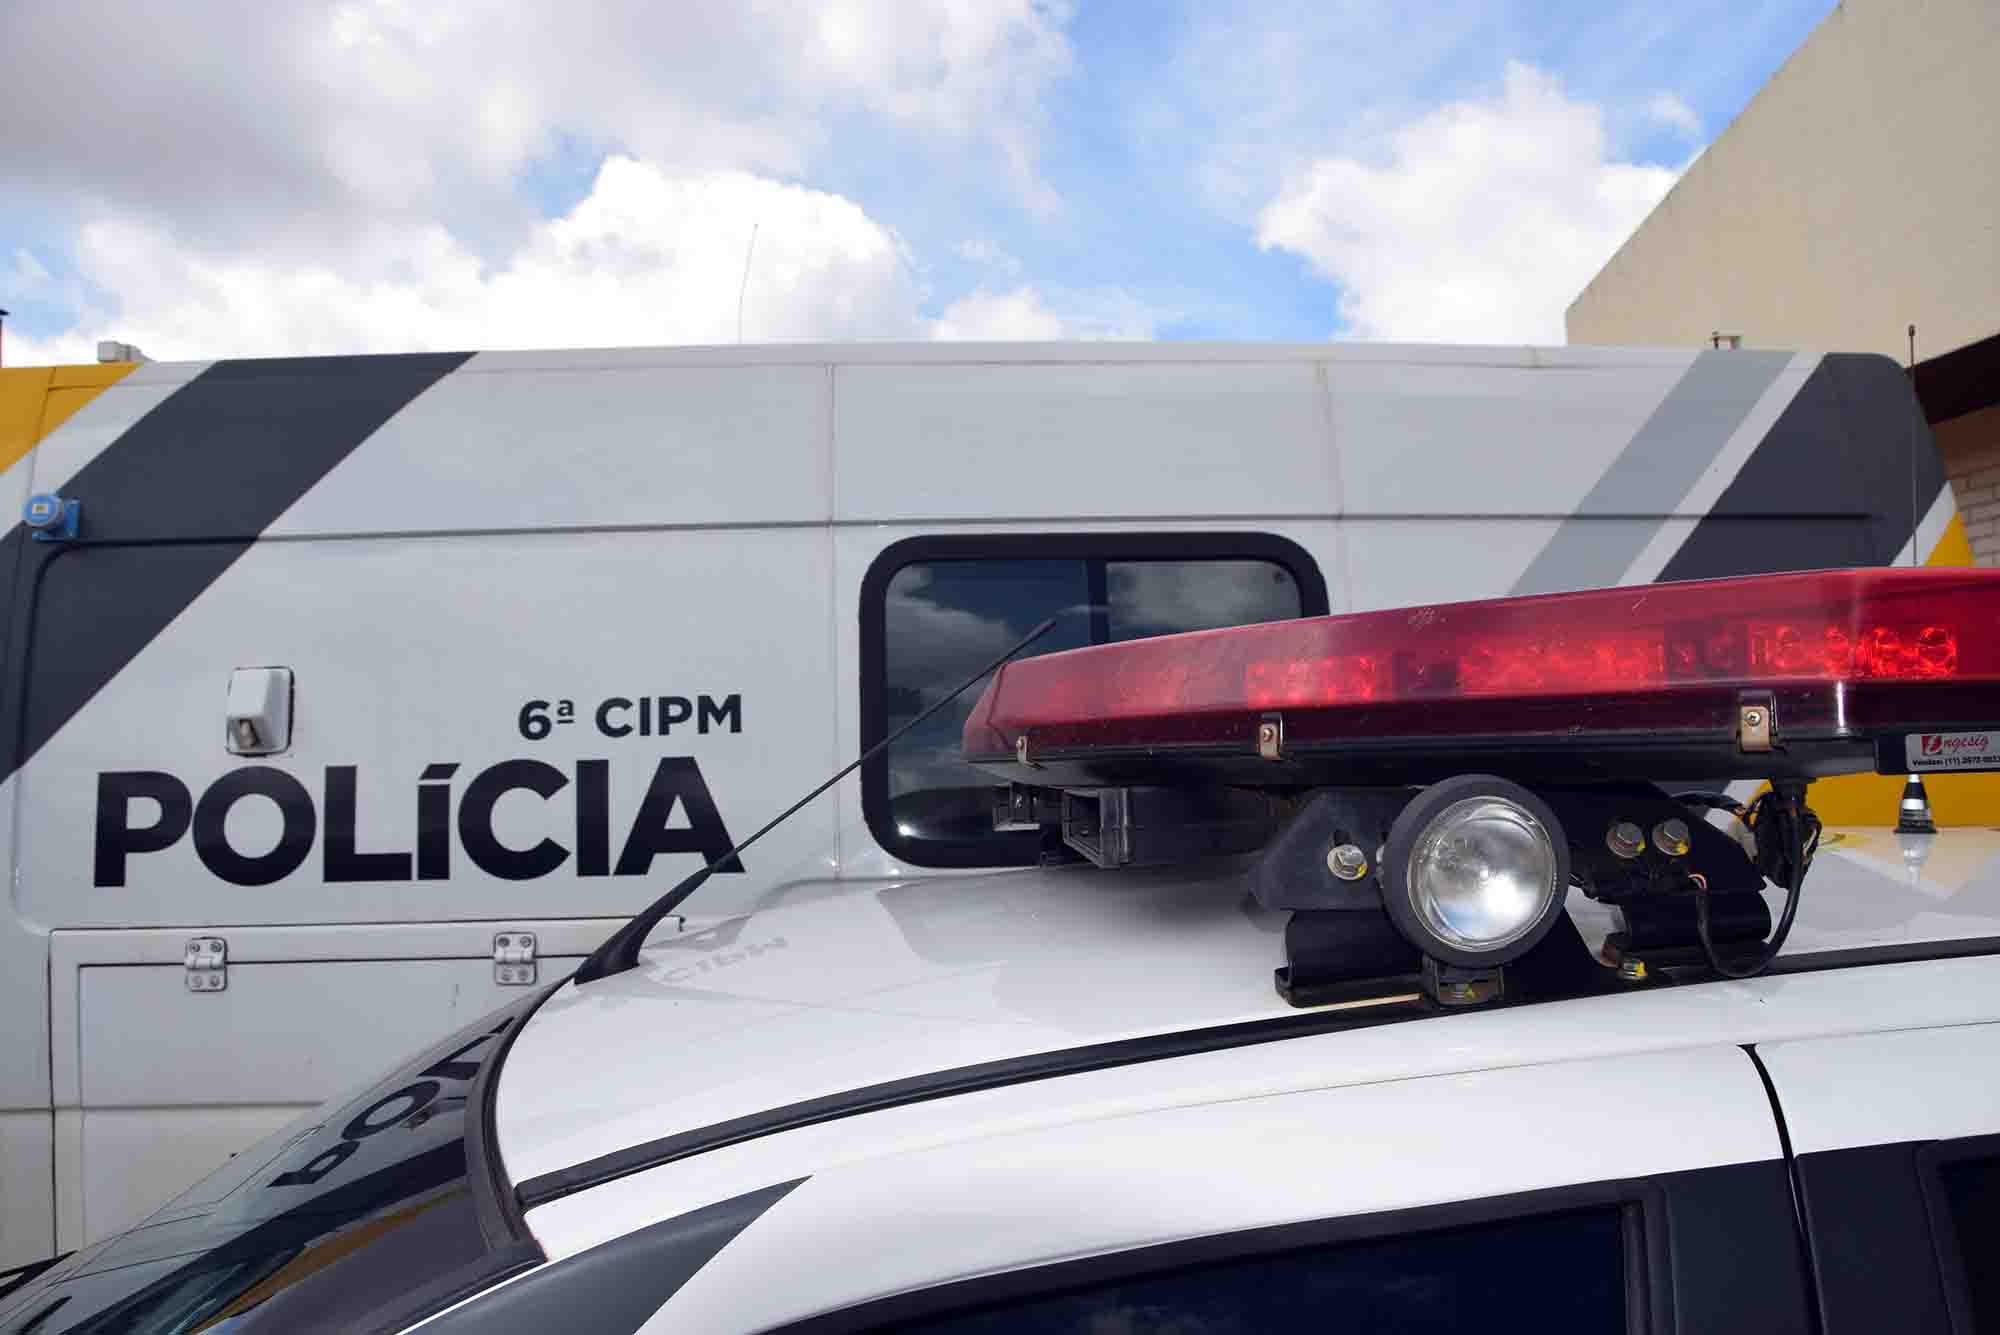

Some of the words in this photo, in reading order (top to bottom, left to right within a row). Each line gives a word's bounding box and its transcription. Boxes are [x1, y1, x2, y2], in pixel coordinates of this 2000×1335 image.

[518, 699, 574, 741] 6ª
[595, 694, 742, 738] CIPM
[94, 756, 746, 888] POLÍCIA
